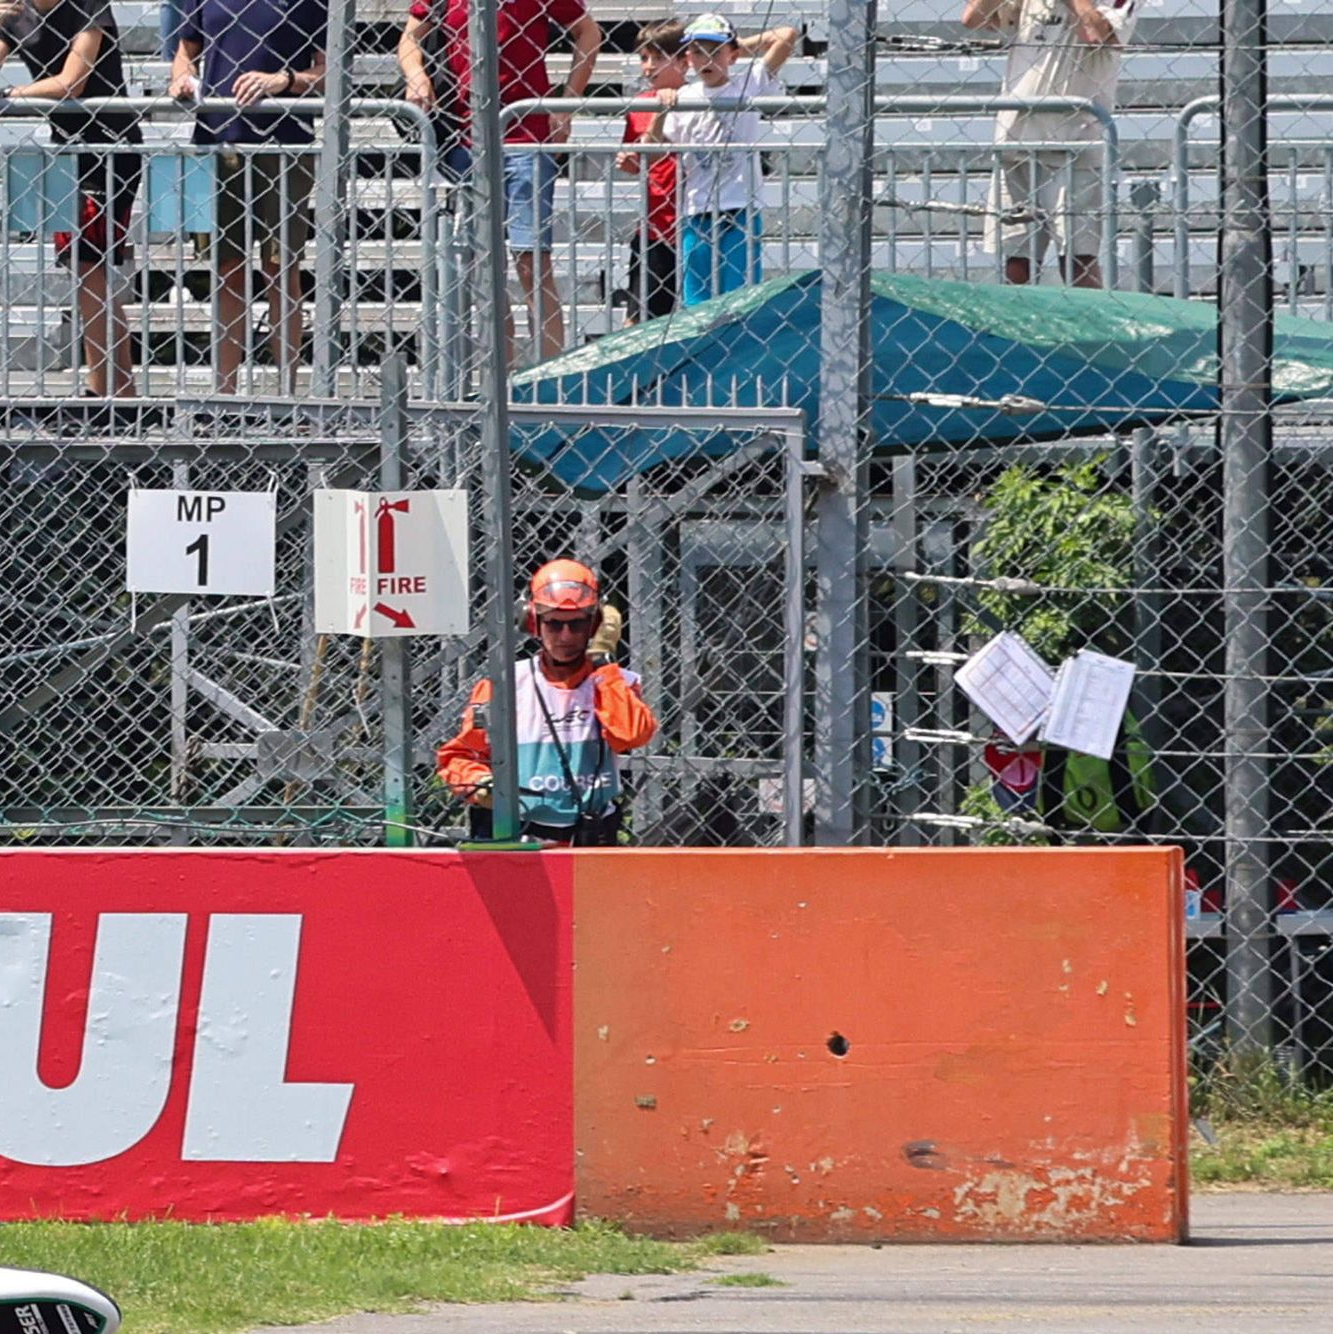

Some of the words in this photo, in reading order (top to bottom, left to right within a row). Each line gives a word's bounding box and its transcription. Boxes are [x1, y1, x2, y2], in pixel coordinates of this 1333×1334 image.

[177, 496, 226, 522] MP
[186, 534, 209, 586] 1
[377, 576, 426, 594] FIRE
[528, 772, 611, 792] COURSE
